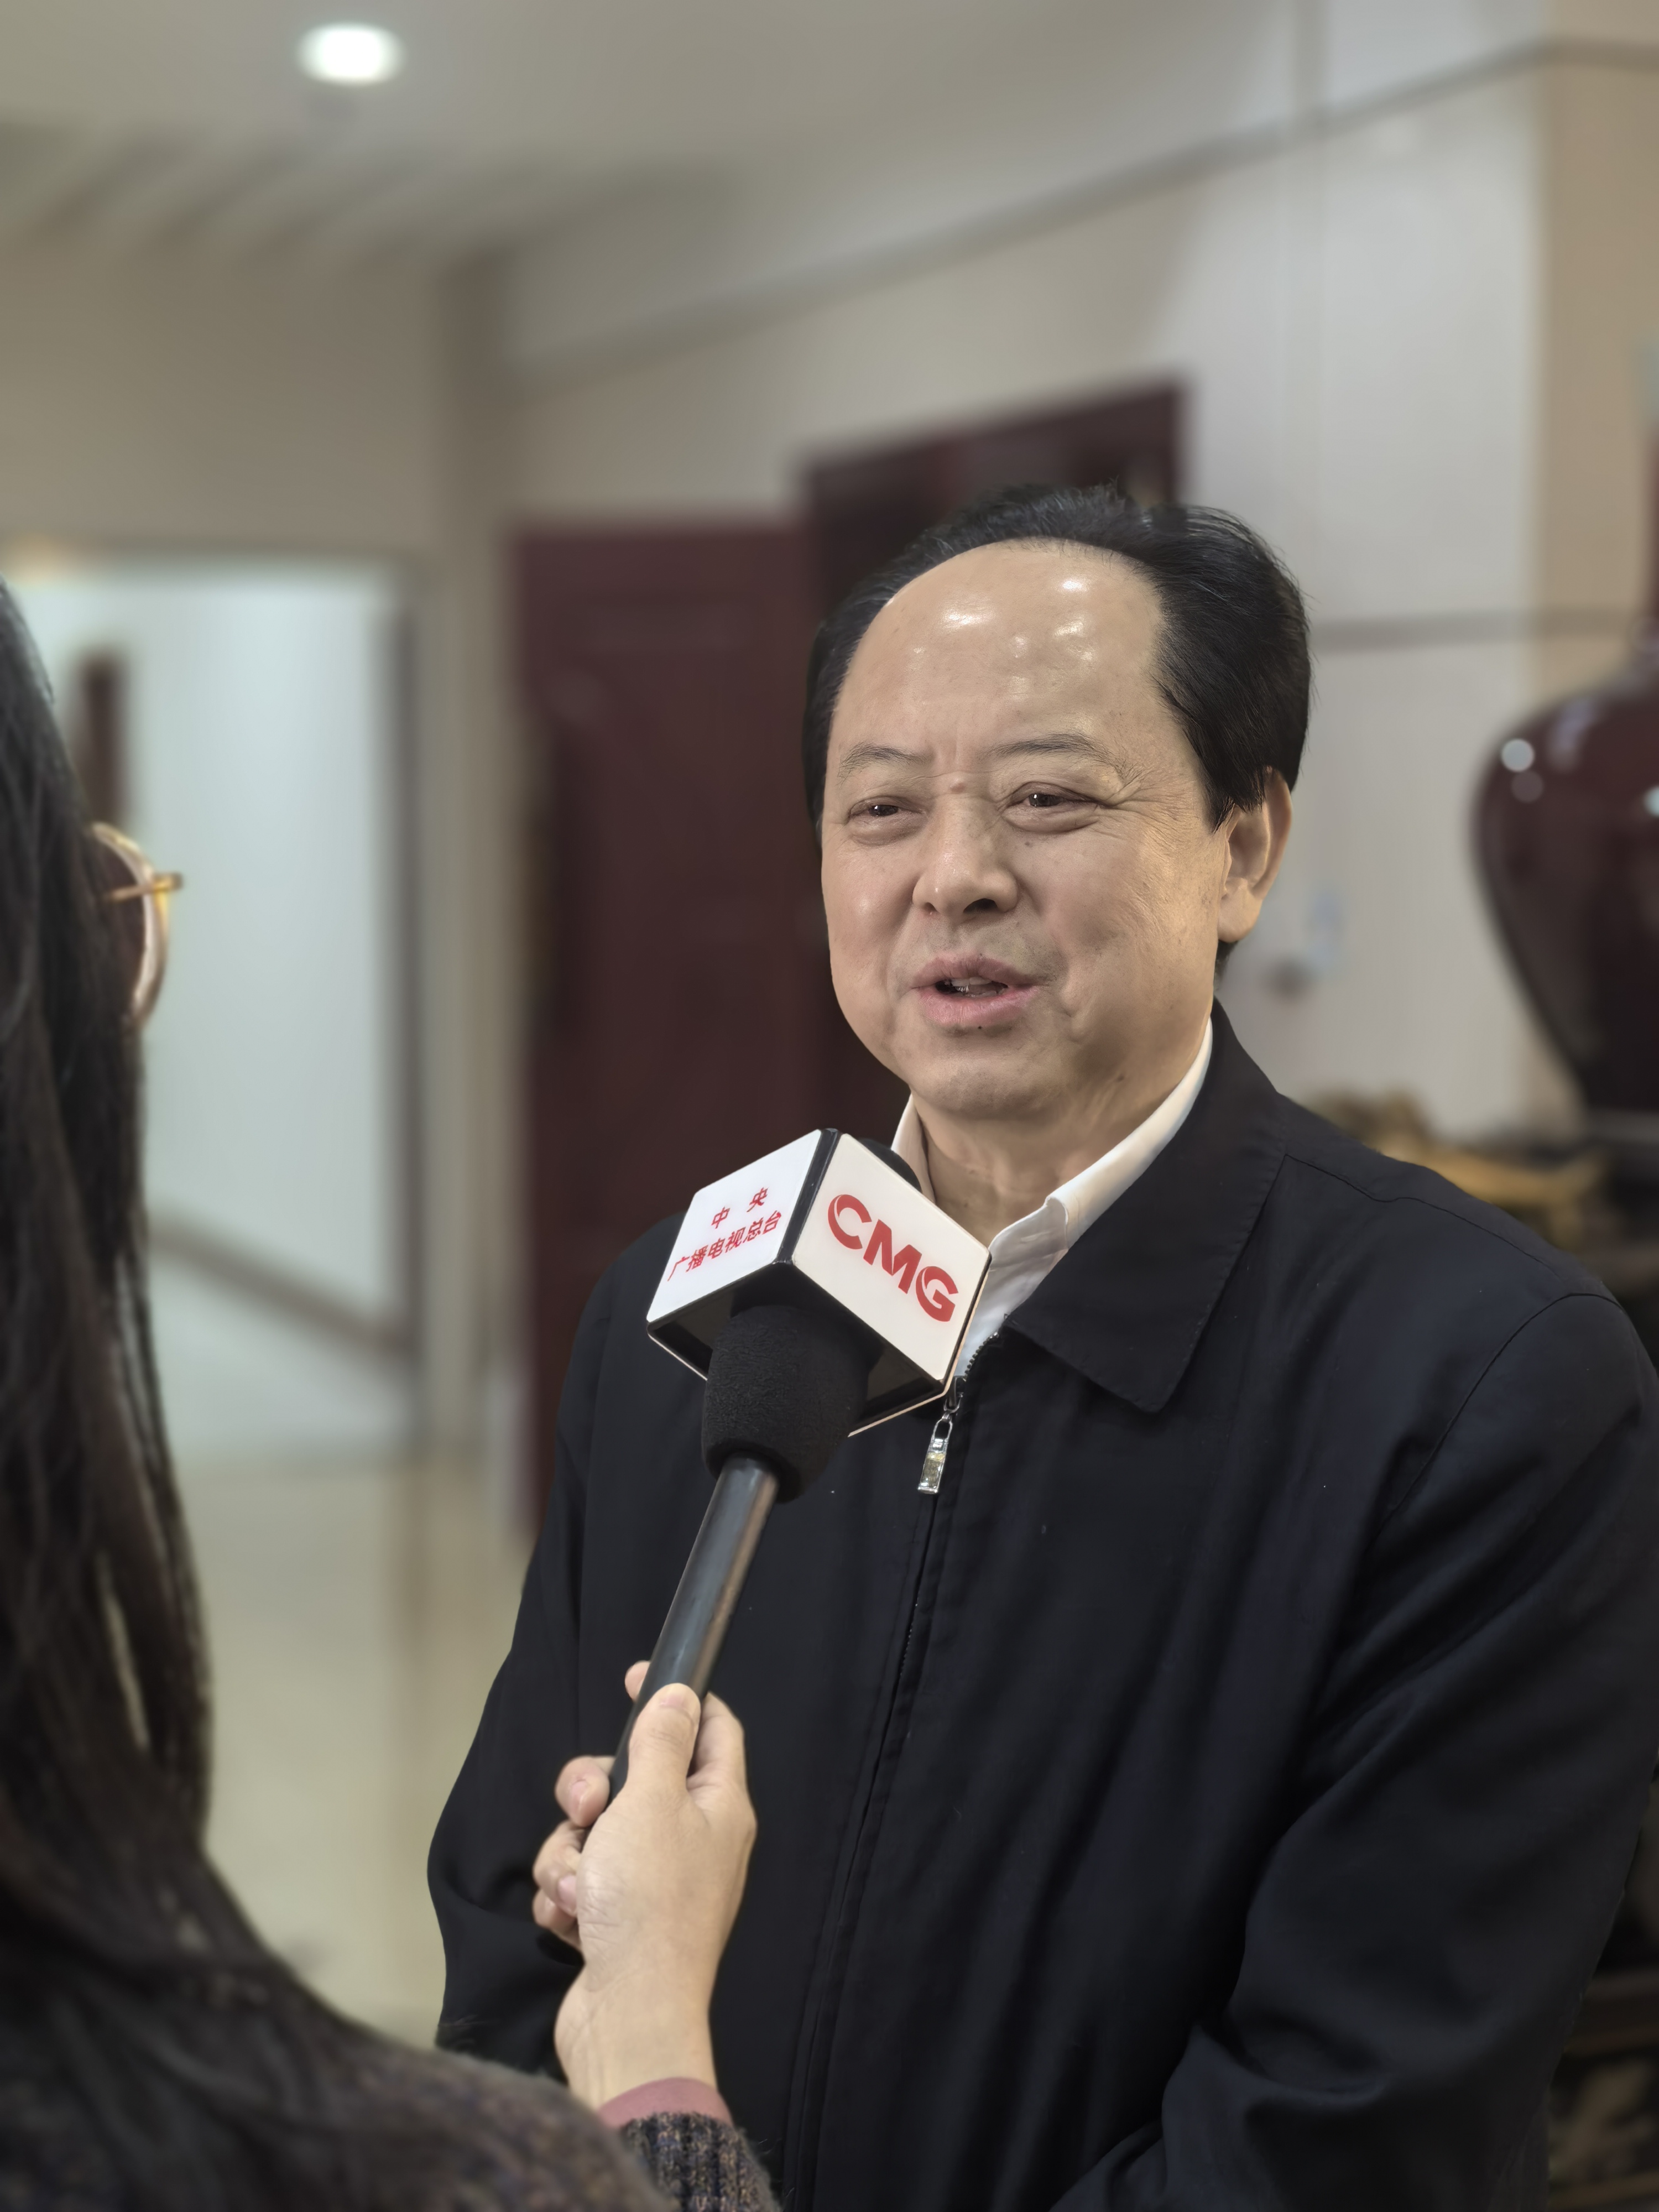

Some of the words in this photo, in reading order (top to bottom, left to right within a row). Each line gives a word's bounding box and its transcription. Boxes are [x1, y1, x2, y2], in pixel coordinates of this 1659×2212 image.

[667, 1211, 782, 1281] 广播电视总台
[827, 1194, 959, 1322] CMG
